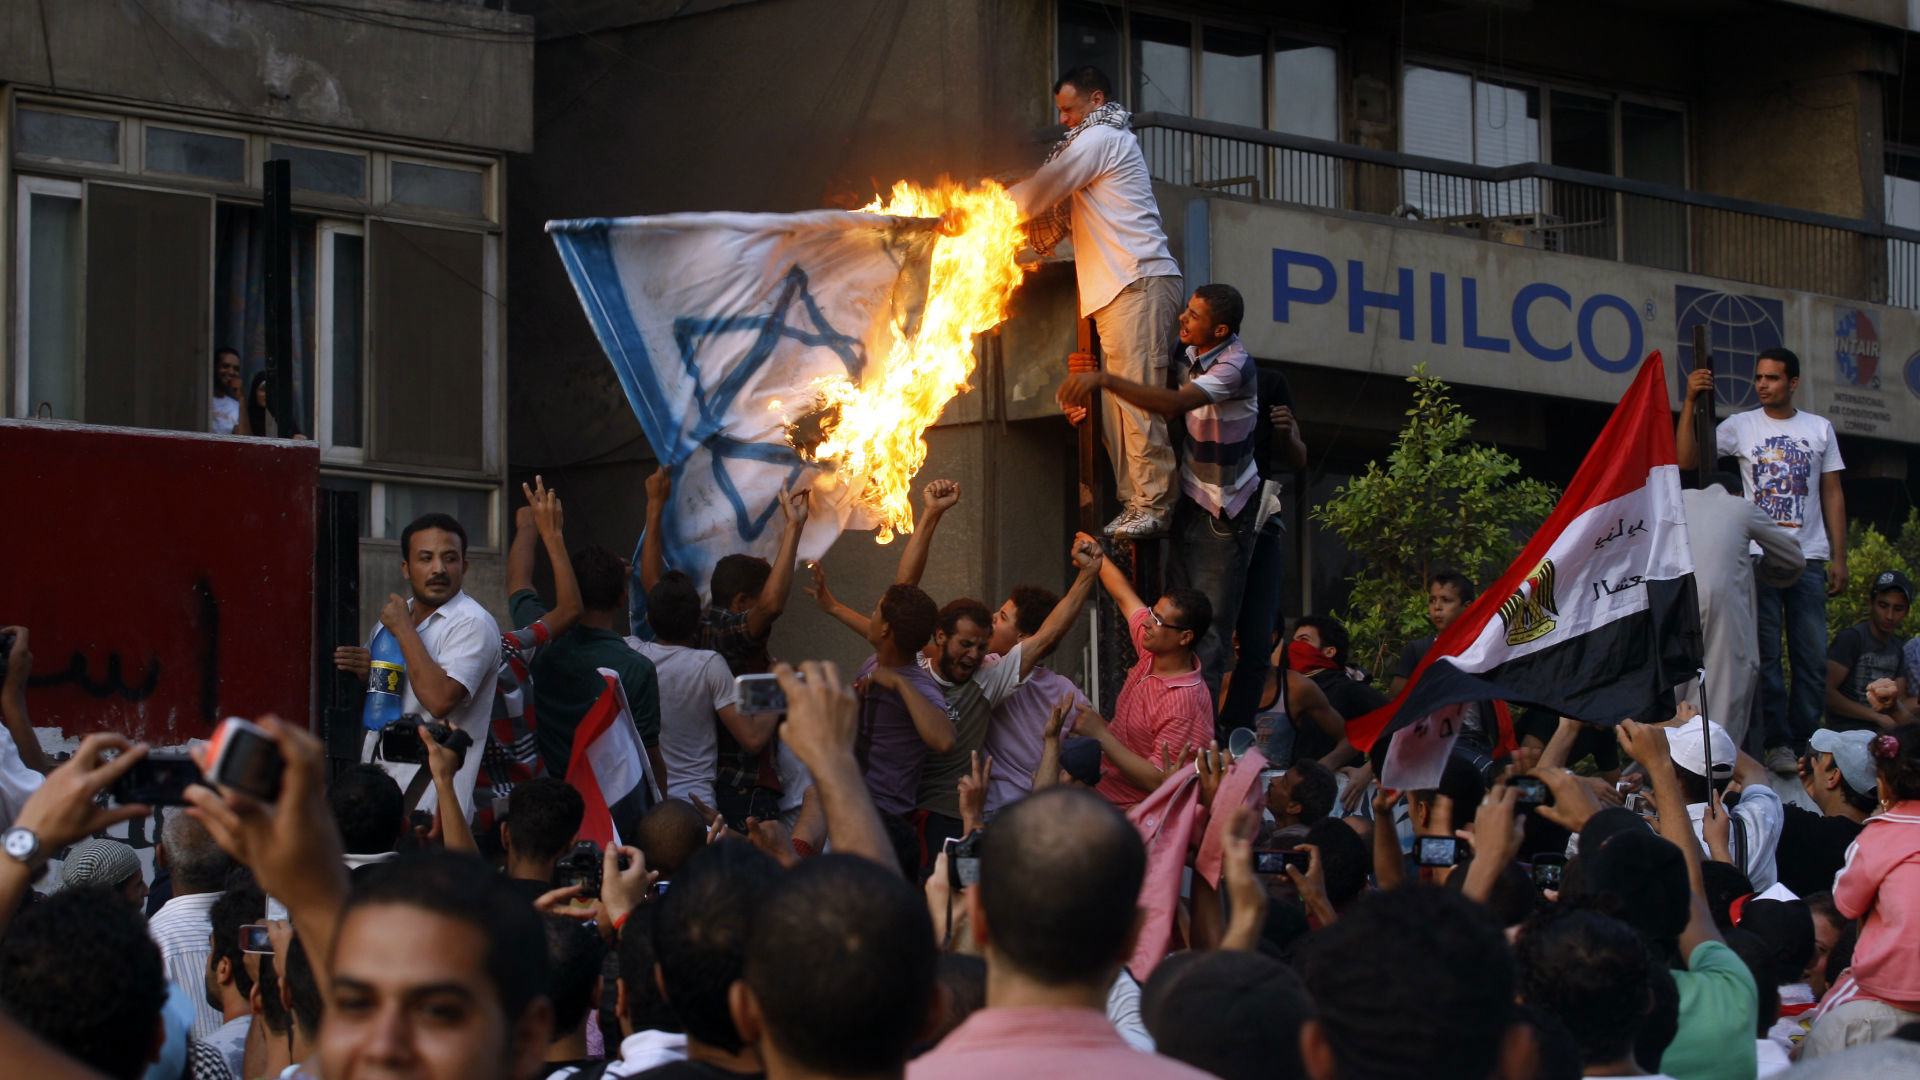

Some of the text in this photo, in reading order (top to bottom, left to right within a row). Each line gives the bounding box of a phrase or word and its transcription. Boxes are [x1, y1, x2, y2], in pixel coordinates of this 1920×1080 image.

[1272, 248, 1644, 374] PHILCO
[1835, 335, 1880, 359] INTAIR
[1833, 392, 1885, 408] INTERNATIONAL
[1829, 405, 1891, 422] AIR CONDITIONING
[1844, 420, 1877, 433] COMPANY
